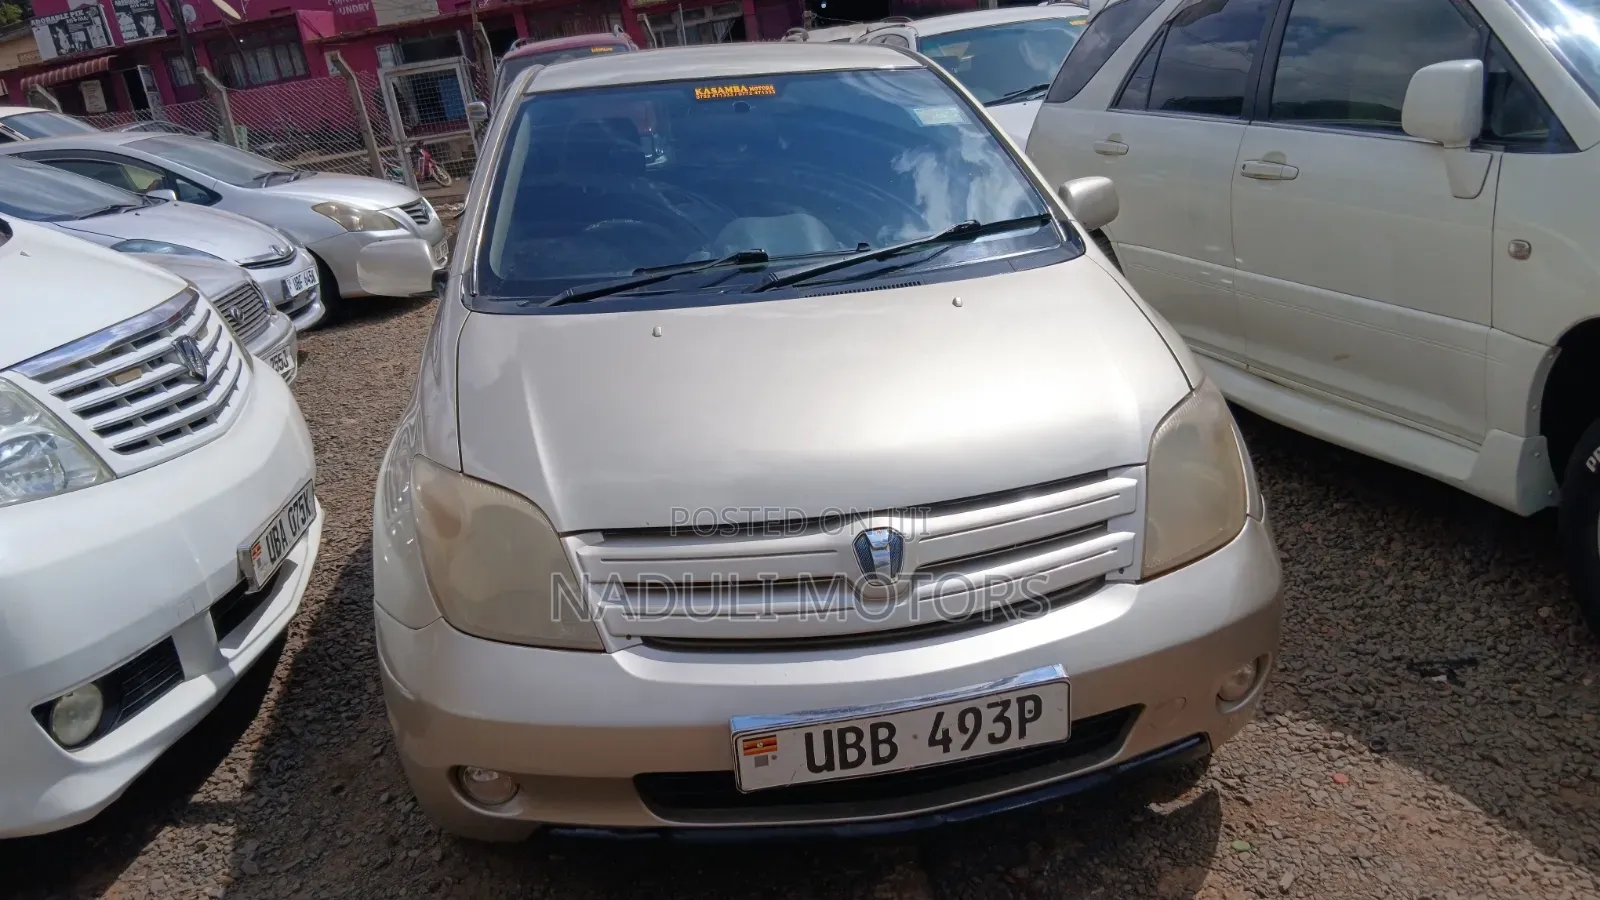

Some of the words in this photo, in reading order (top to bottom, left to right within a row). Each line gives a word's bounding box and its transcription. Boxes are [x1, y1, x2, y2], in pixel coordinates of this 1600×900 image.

[695, 85, 749, 96] KASAMBA
[265, 518, 289, 565] UBA
[804, 721, 900, 774] UBB
[927, 693, 1043, 755] 493P
